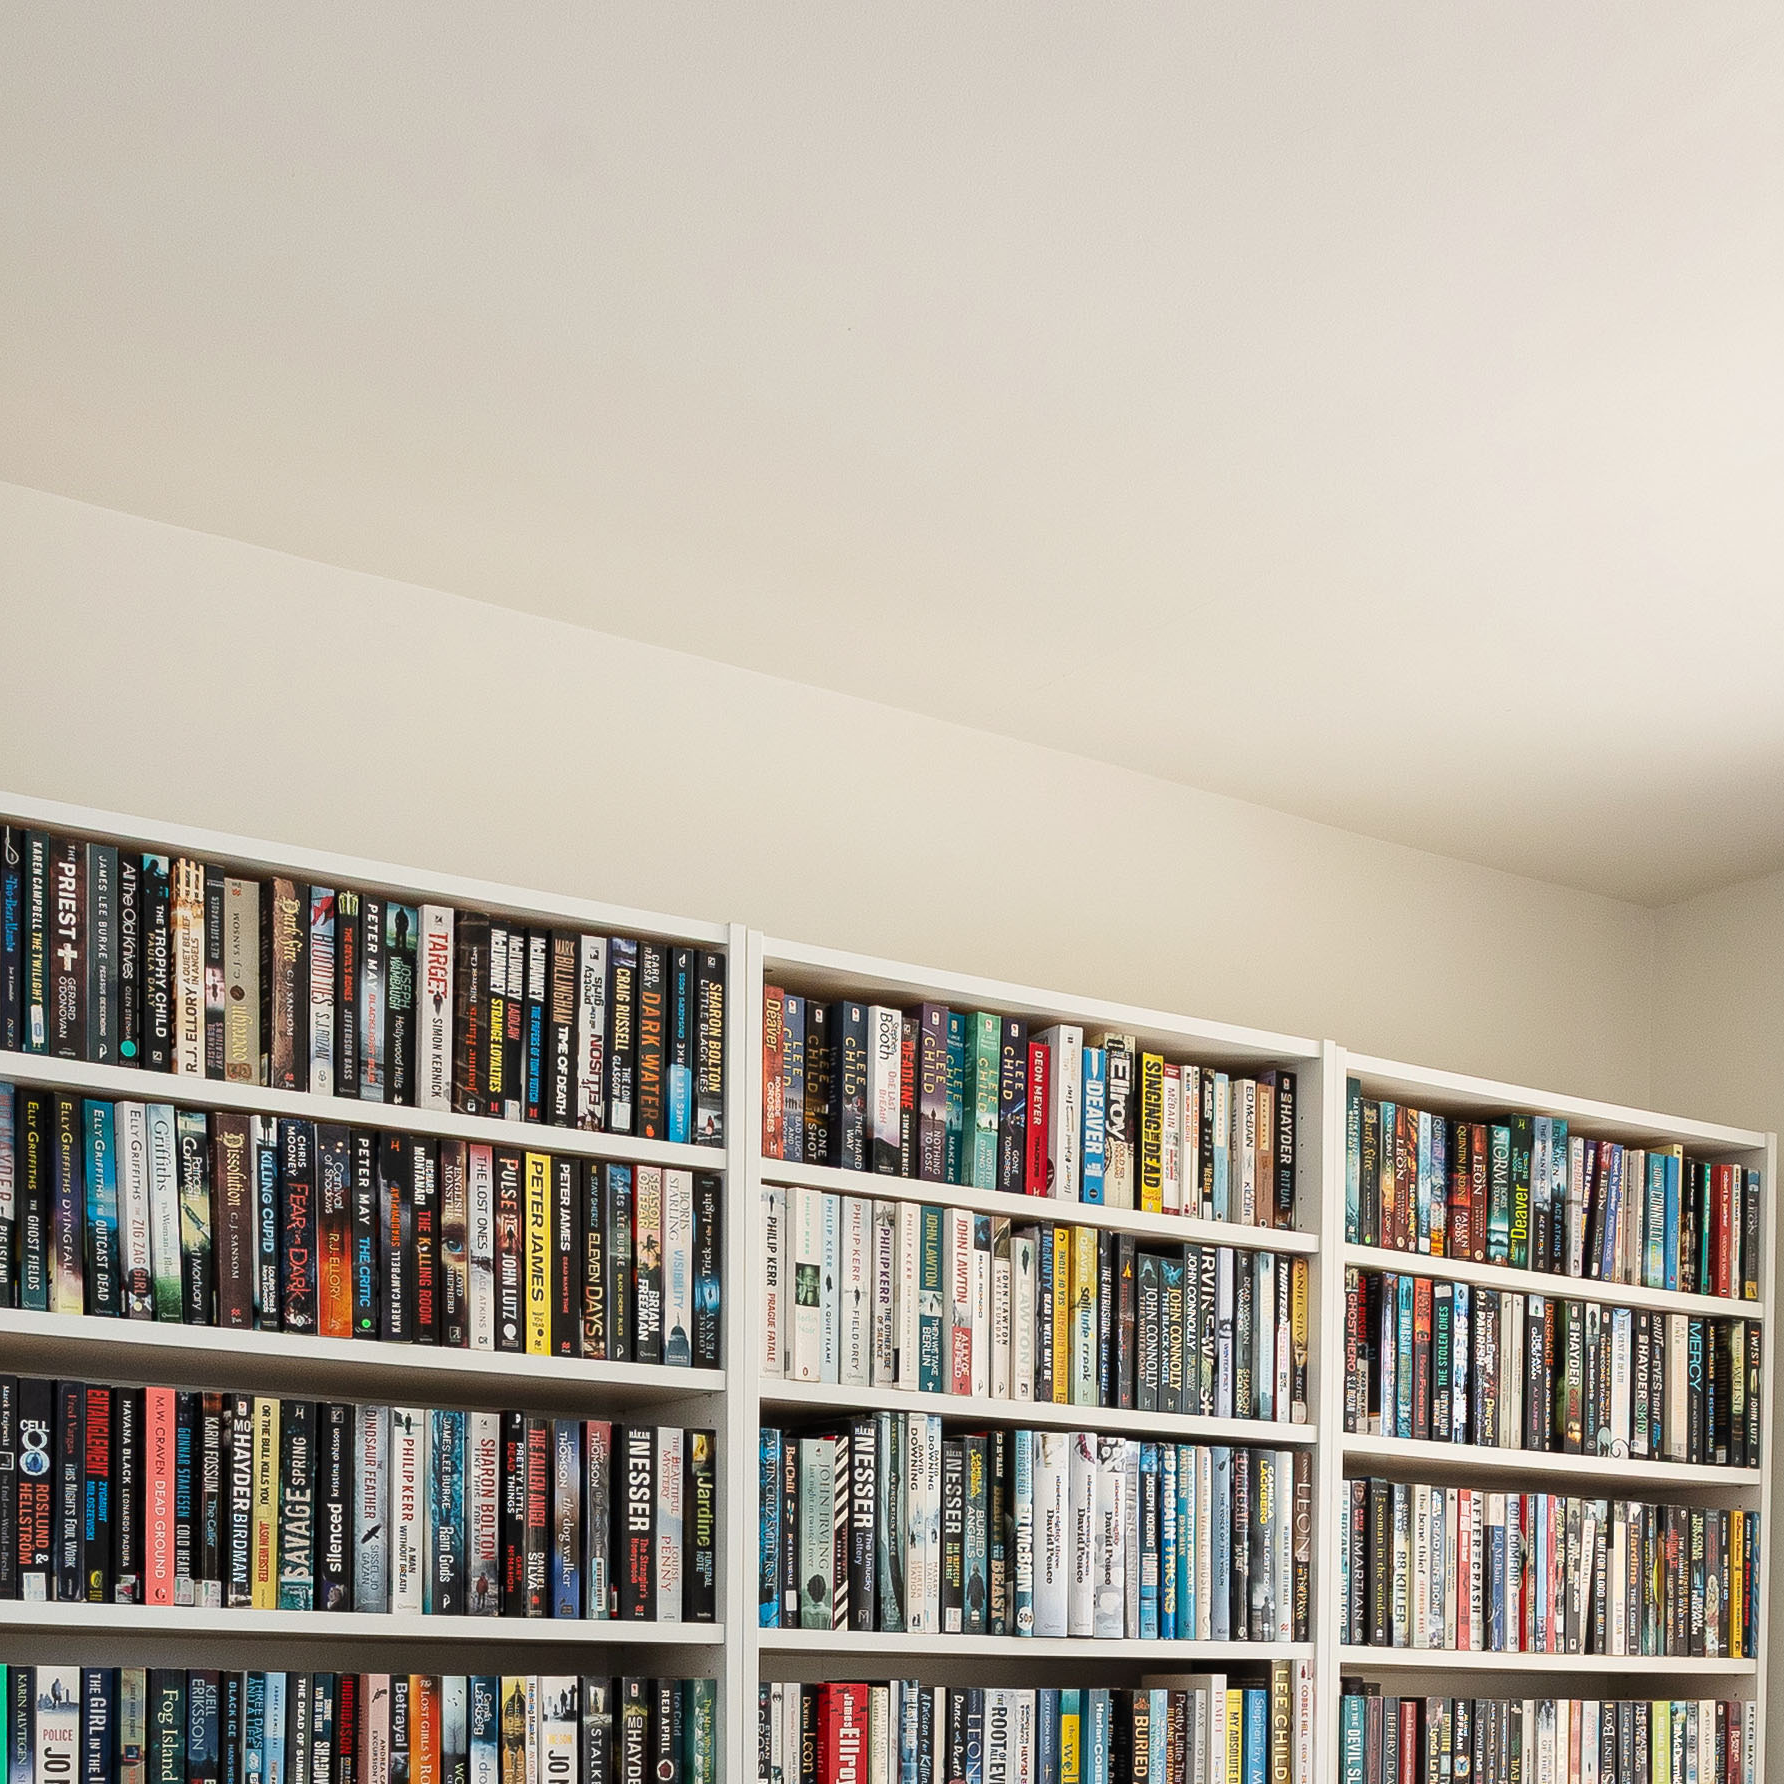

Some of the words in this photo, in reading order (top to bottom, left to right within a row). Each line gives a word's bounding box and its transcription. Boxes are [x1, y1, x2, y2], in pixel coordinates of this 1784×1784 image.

[59, 862, 75, 939] PRIEST
[368, 905, 378, 954] PETER
[156, 928, 166, 981] TROPHY
[367, 959, 377, 990] MAY
[155, 985, 166, 1037] CHILD
[642, 993, 660, 1046] DARK
[558, 1027, 568, 1054] TIME
[559, 1057, 568, 1068] OF
[640, 1054, 660, 1120] WATER
[1034, 1051, 1043, 1082] DEON
[556, 1073, 568, 1115] DEATH
[1032, 1085, 1042, 1125] MEYER
[1086, 1081, 1103, 1154] DEAVER
[1280, 1106, 1292, 1164] HAYDER
[261, 1151, 273, 1204] KILLING
[531, 1160, 543, 1227] PETER
[1279, 1170, 1291, 1209] RITUAL
[261, 1208, 274, 1252] CUPID
[768, 1216, 777, 1253] PHILIP
[1511, 1185, 1529, 1239] Deaver
[98, 1221, 109, 1268] OUTCAST
[359, 1239, 370, 1262] THE
[956, 1219, 967, 1255] JOHN
[98, 1271, 108, 1301] DEAD
[358, 1265, 370, 1307] CRITIC
[502, 1253, 517, 1289] JOHN
[530, 1233, 543, 1302] JAMES
[767, 1257, 777, 1286] KERR
[956, 1259, 967, 1304] LAWTON
[502, 1292, 516, 1320] LUTZ
[1146, 1286, 1157, 1316] JOHN
[851, 1344, 859, 1370] GREY
[1146, 1319, 1157, 1390] CONNOLLY
[1689, 1323, 1702, 1391] MERCY
[233, 1432, 251, 1514] HAYDER
[292, 1437, 307, 1485] SPRING
[403, 1439, 414, 1481] PHILIP
[481, 1439, 496, 1494] SHARON
[854, 1436, 874, 1528] NESSER
[155, 1480, 166, 1515] DEAD
[402, 1485, 414, 1521] KERR
[629, 1441, 650, 1532] NESSER
[36, 1484, 49, 1549] ROSLUND
[329, 1503, 342, 1572] silenced
[480, 1504, 495, 1560] BOLTON
[154, 1521, 166, 1579] GROUND
[232, 1517, 248, 1582] BIRDMAN
[1354, 1543, 1363, 1621] MARTIAN
[158, 1689, 178, 1722] Fog
[1275, 1669, 1287, 1713] LEE
[43, 1729, 73, 1741] POLICE
[90, 1697, 106, 1735] GIRL
[395, 1683, 407, 1751] Betrayal
[991, 1707, 1007, 1750] ROOT
[44, 1748, 69, 1772] JO
[163, 1729, 178, 1781] Island
[549, 1751, 569, 1772] JO
[1134, 1716, 1148, 1776] BURIED
[1275, 1716, 1287, 1780] CHILD
